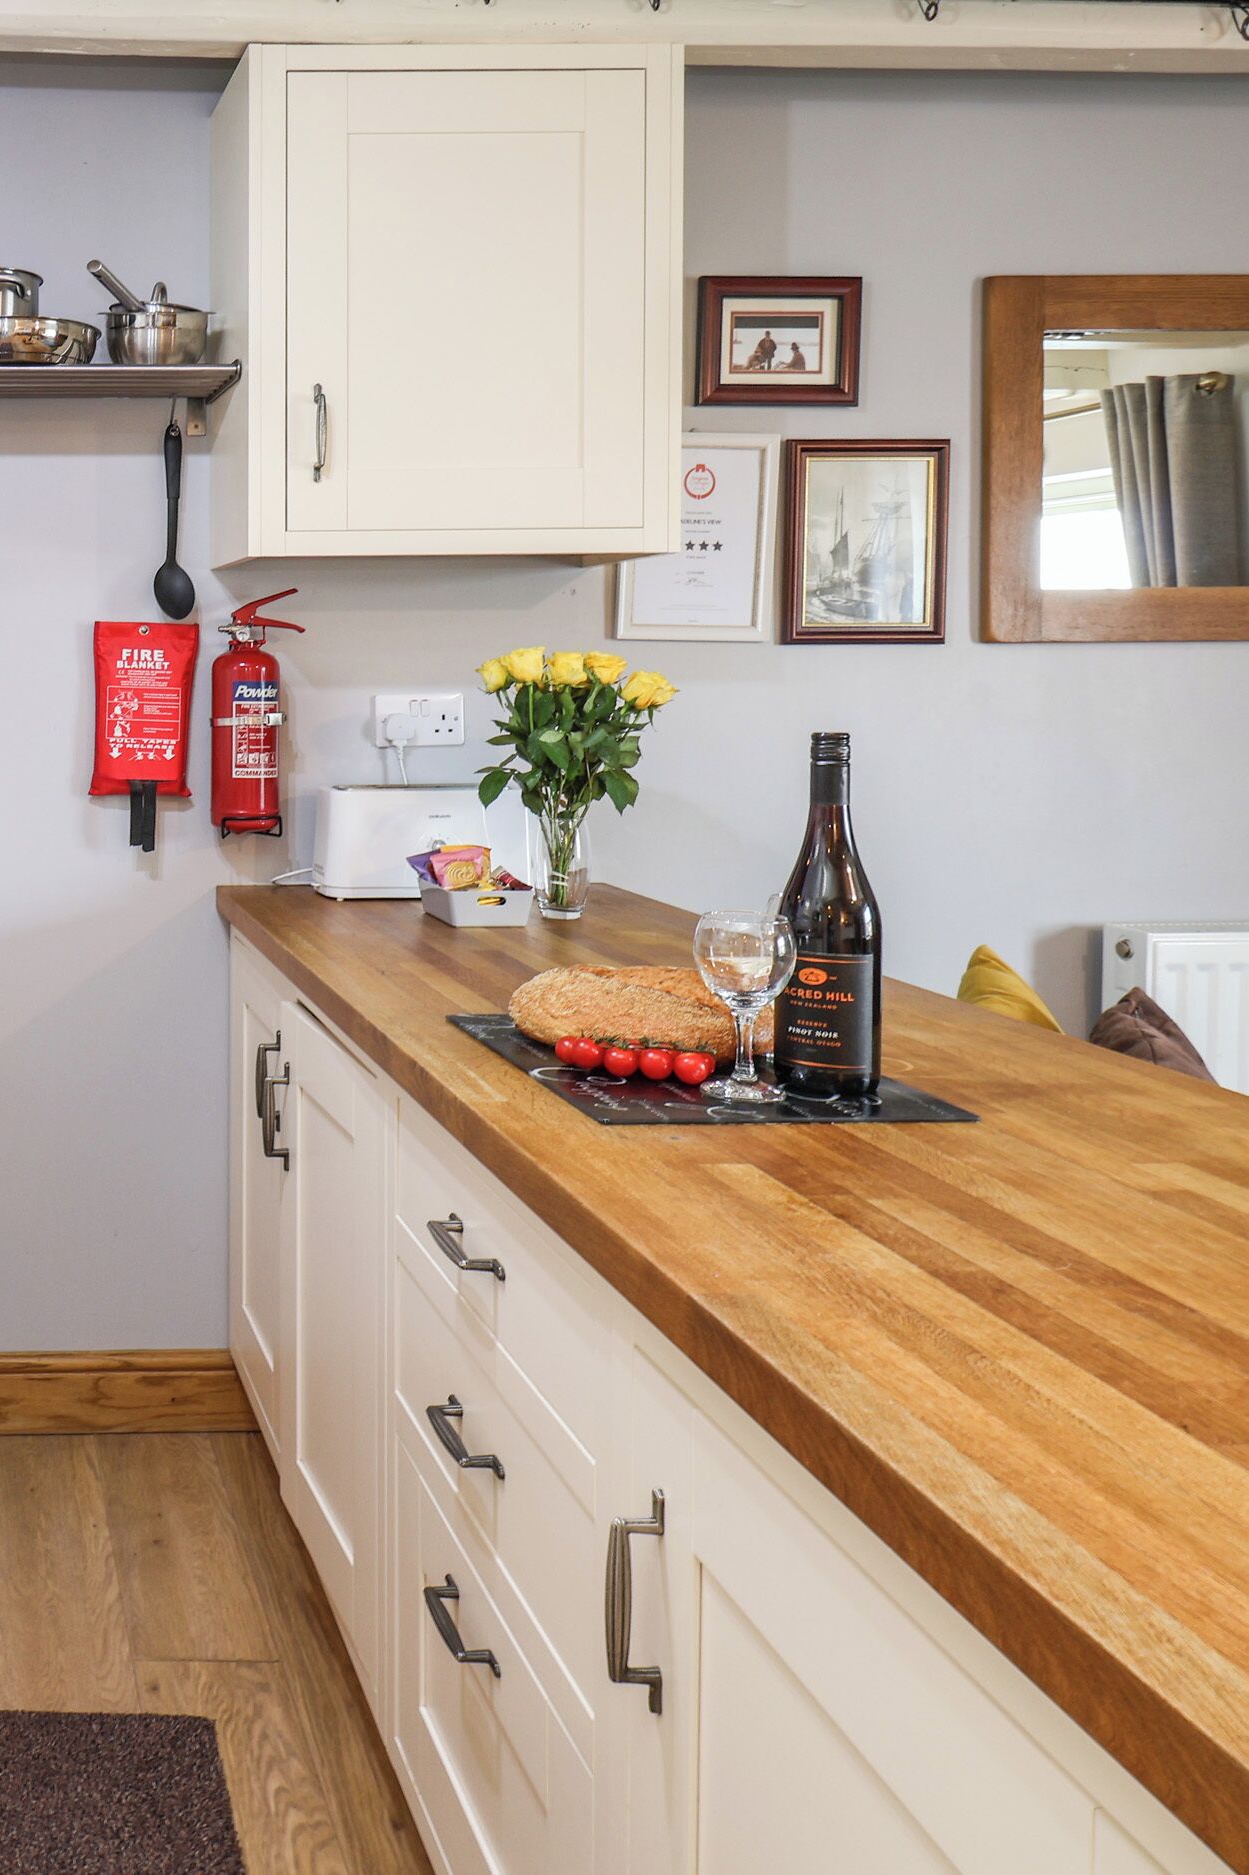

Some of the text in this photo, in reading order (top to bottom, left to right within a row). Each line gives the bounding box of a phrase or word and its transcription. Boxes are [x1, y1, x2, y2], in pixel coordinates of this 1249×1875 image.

[121, 648, 165, 662] FIRE
[116, 660, 170, 670] BLANKET
[234, 685, 278, 698] Powder
[783, 986, 855, 1002] ACRED HILL
[804, 1001, 838, 1010] ZEALAND
[787, 1025, 839, 1039] PINOT NOIR
